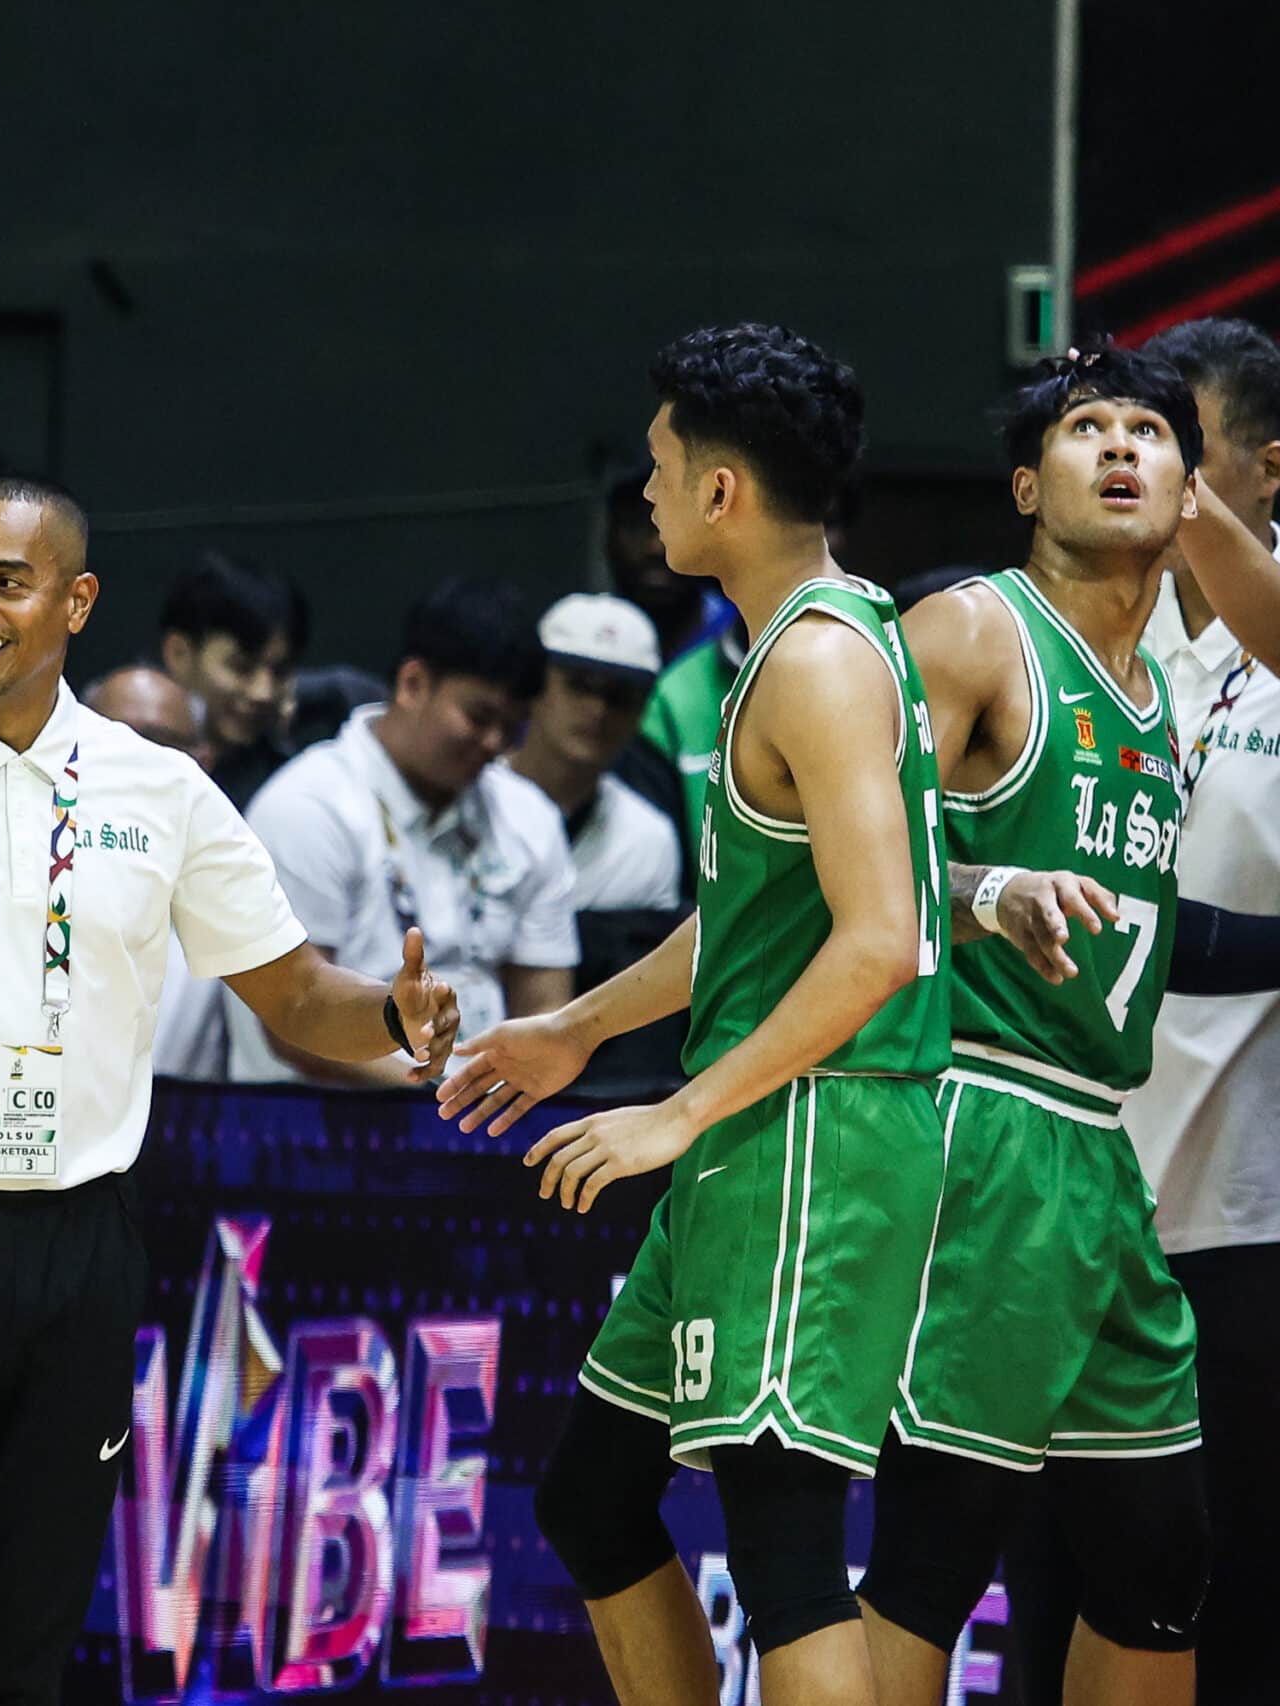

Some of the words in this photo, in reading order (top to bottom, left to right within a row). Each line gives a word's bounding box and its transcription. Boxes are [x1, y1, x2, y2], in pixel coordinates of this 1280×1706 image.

[1217, 724, 1240, 750] La
[1071, 773, 1119, 860] La
[99, 823, 150, 854] Salle
[1104, 892, 1160, 1034] 7
[12, 1090, 27, 1109] C
[34, 1090, 55, 1110] CO
[25, 1158, 34, 1171] 3
[671, 1318, 716, 1404] 19
